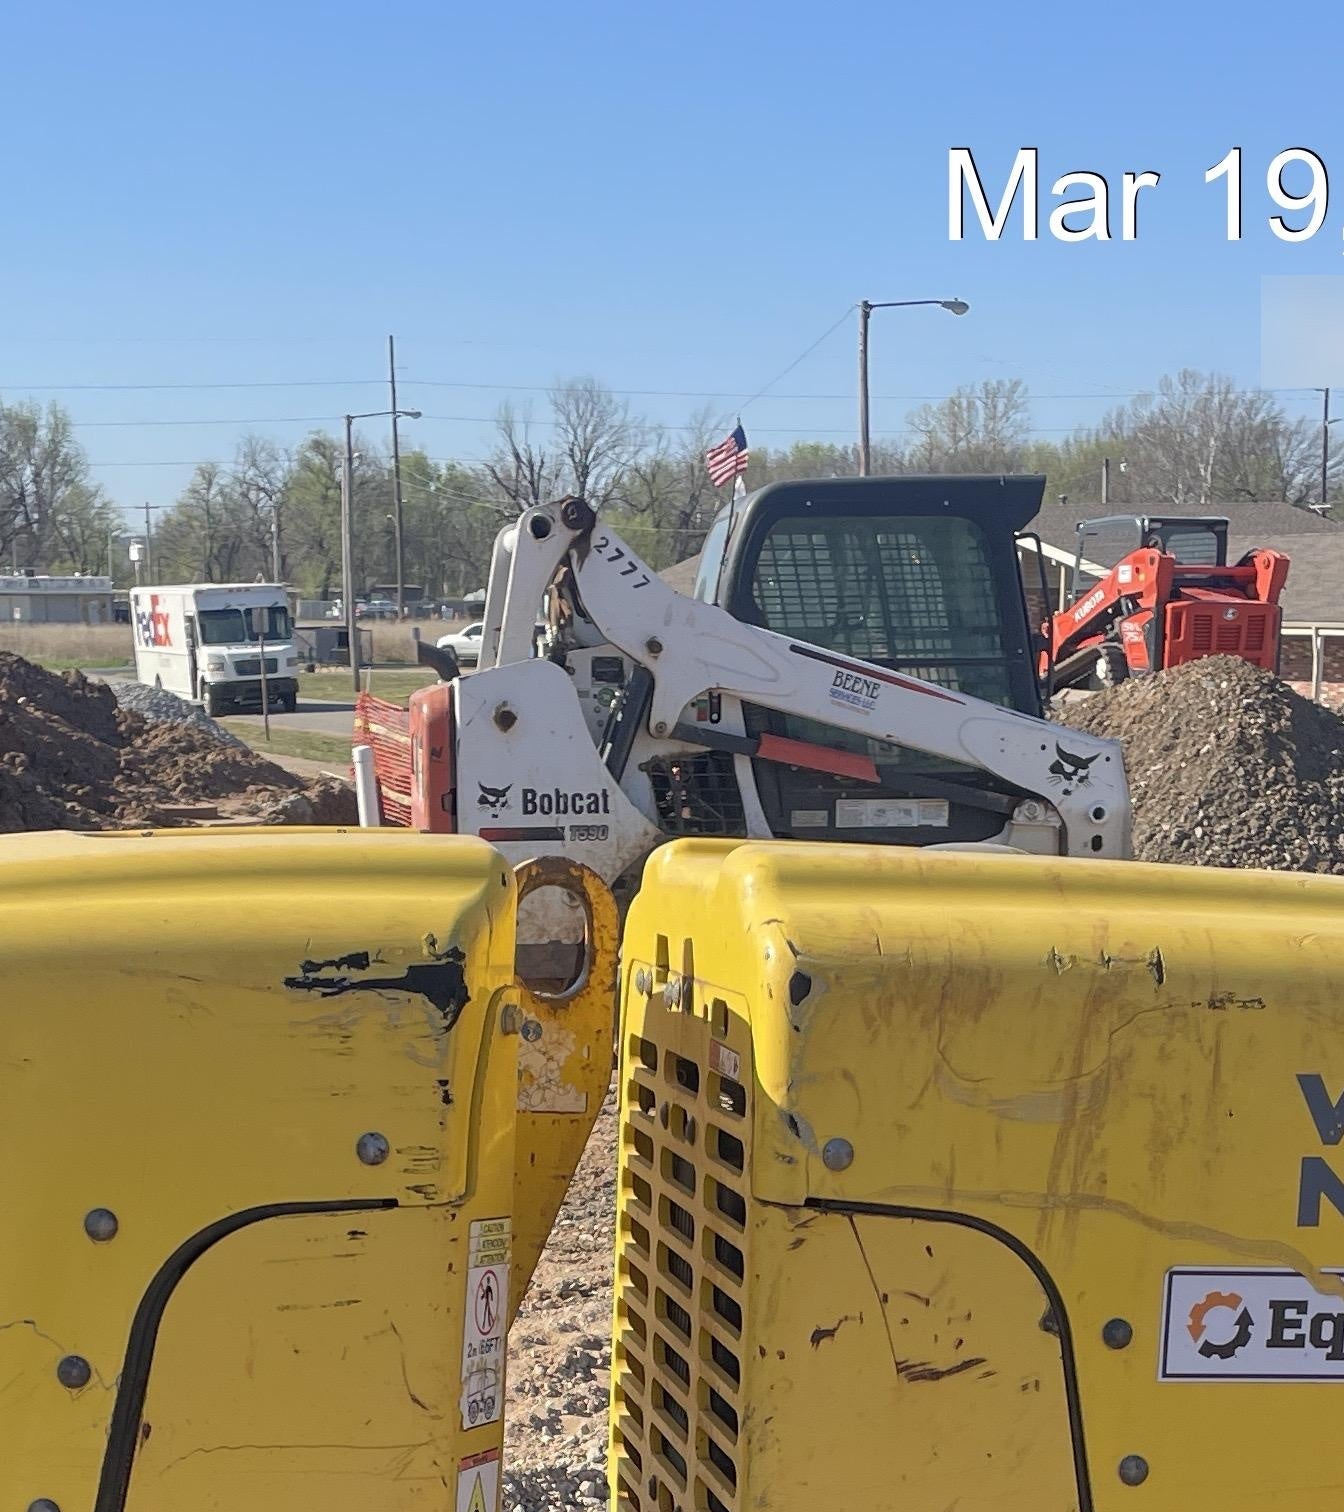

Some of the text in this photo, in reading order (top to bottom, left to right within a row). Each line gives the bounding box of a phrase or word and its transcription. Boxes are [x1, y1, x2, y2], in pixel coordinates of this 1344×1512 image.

[593, 536, 651, 589] 2777
[832, 670, 881, 699] BEENE
[522, 788, 610, 815] Bobcat
[569, 825, 609, 841] T590
